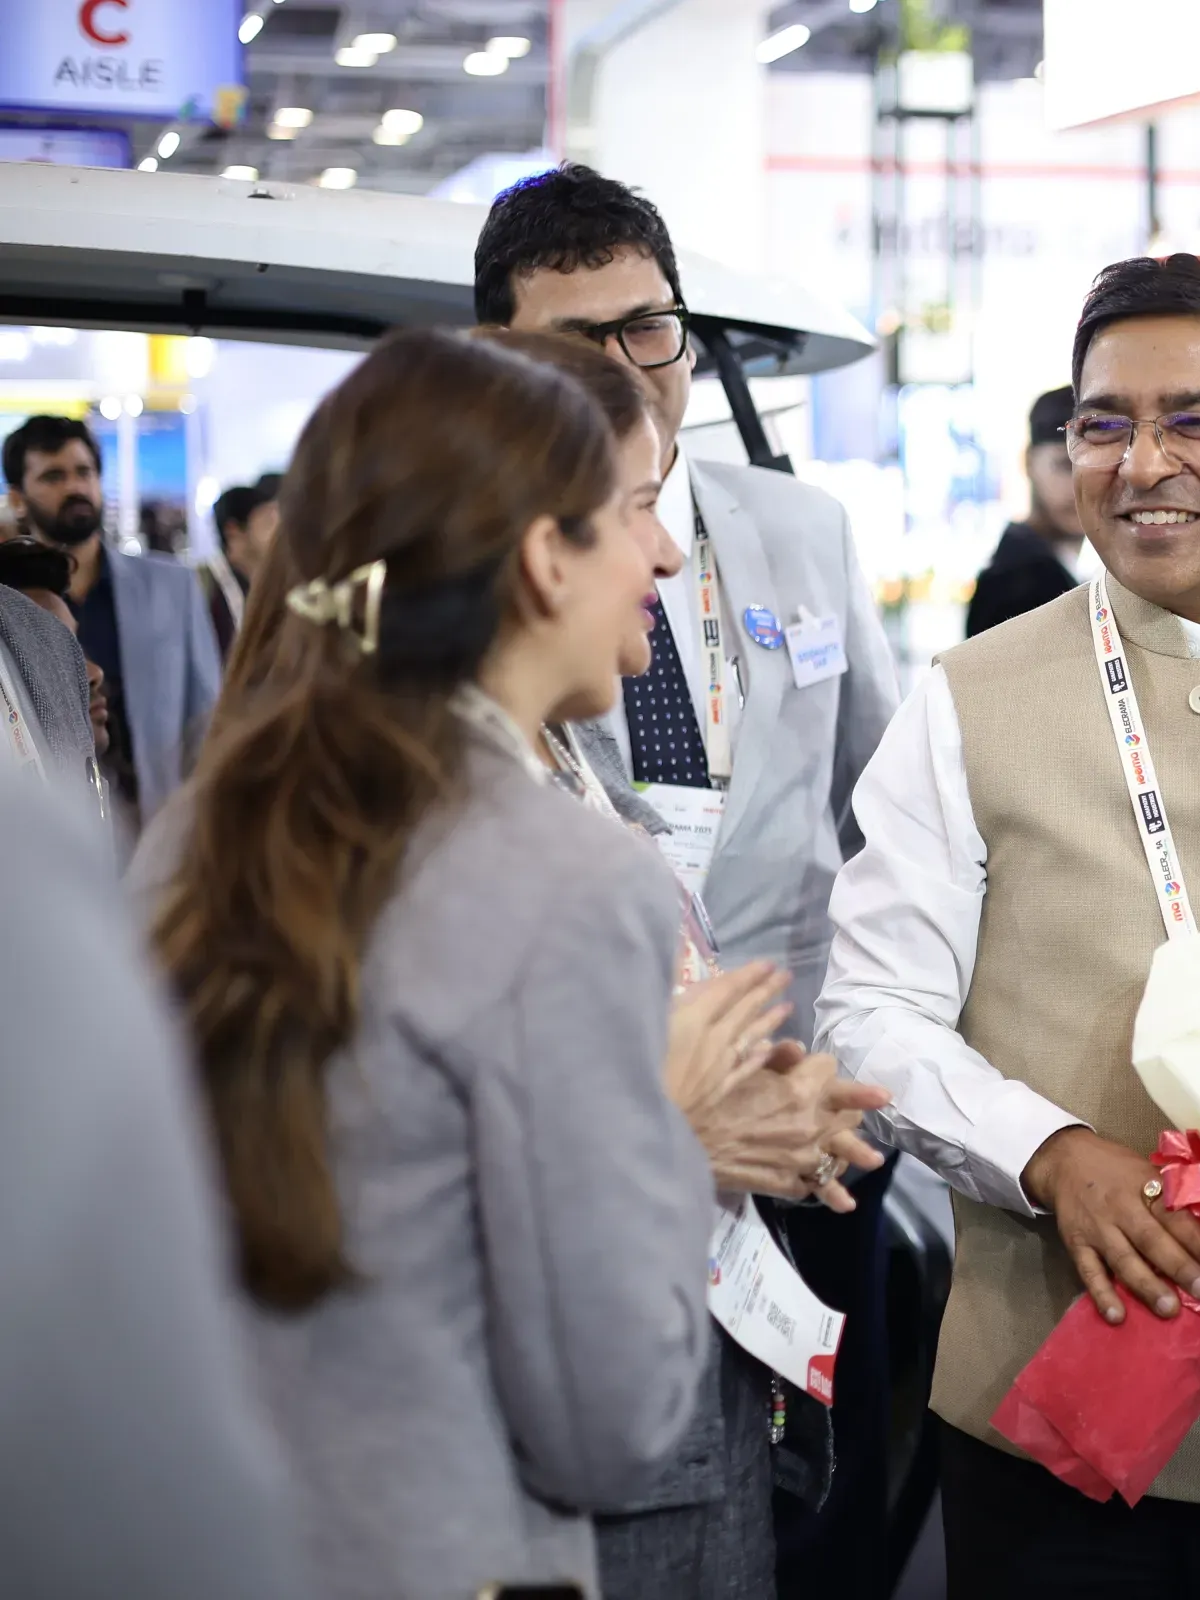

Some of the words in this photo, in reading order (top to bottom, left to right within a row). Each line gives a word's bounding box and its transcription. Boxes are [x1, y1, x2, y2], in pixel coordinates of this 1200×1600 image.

[79, 0, 129, 44] C
[55, 57, 163, 89] AISLE
[1118, 698, 1132, 733] ELECRAMA
[1131, 752, 1145, 785] ieema
